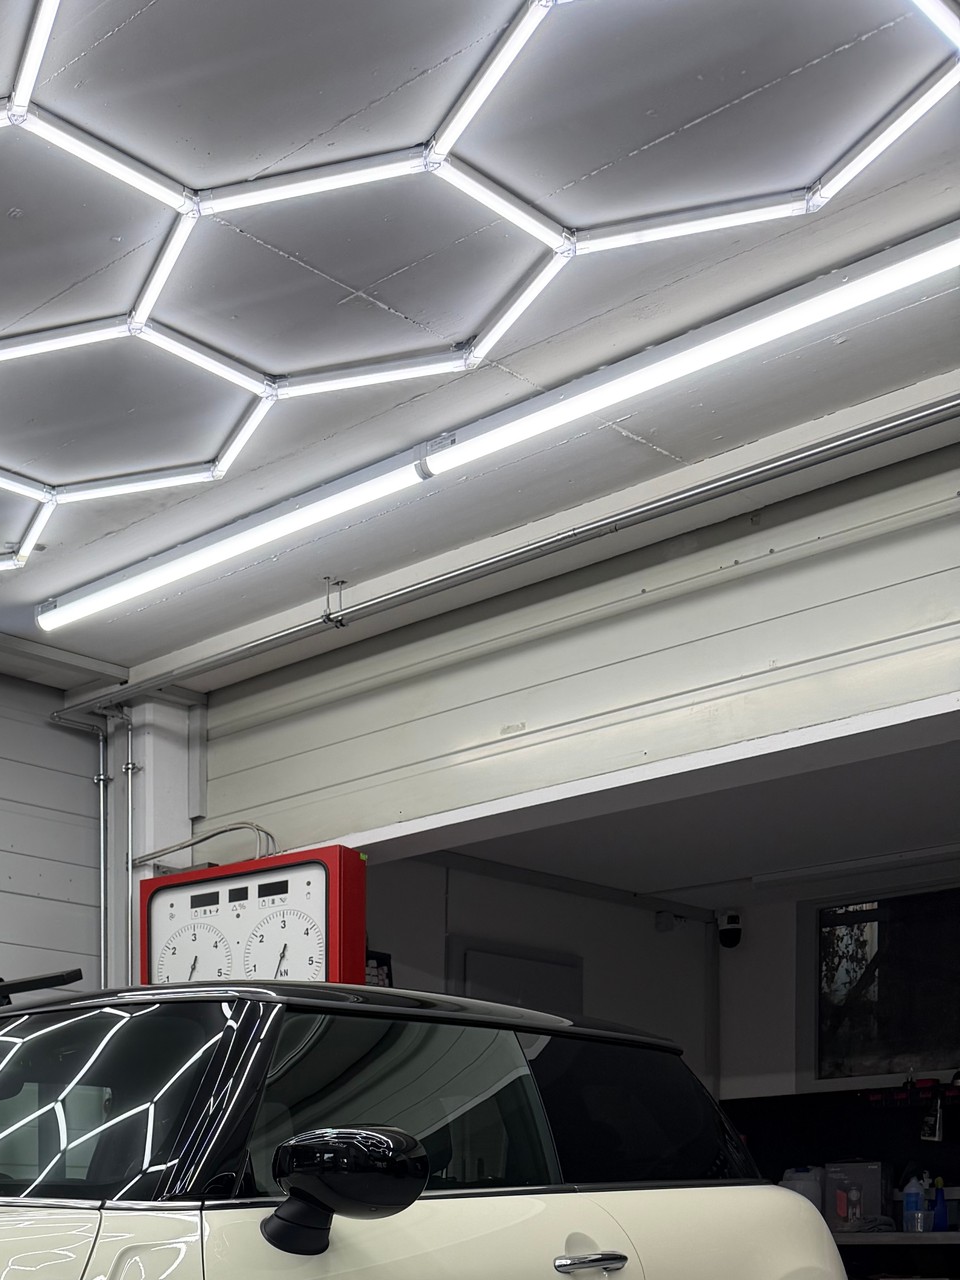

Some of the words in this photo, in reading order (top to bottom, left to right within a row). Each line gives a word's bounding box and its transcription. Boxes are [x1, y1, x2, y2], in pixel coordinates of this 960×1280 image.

[280, 920, 286, 929] 3
[303, 928, 309, 936] 4
[191, 933, 197, 942] 3
[258, 934, 264, 943] 2
[212, 941, 218, 949] 4
[171, 947, 177, 955] 2
[308, 956, 314, 965] 5
[253, 964, 257, 972] 1
[217, 968, 223, 977] 5
[280, 969, 289, 977] kN
